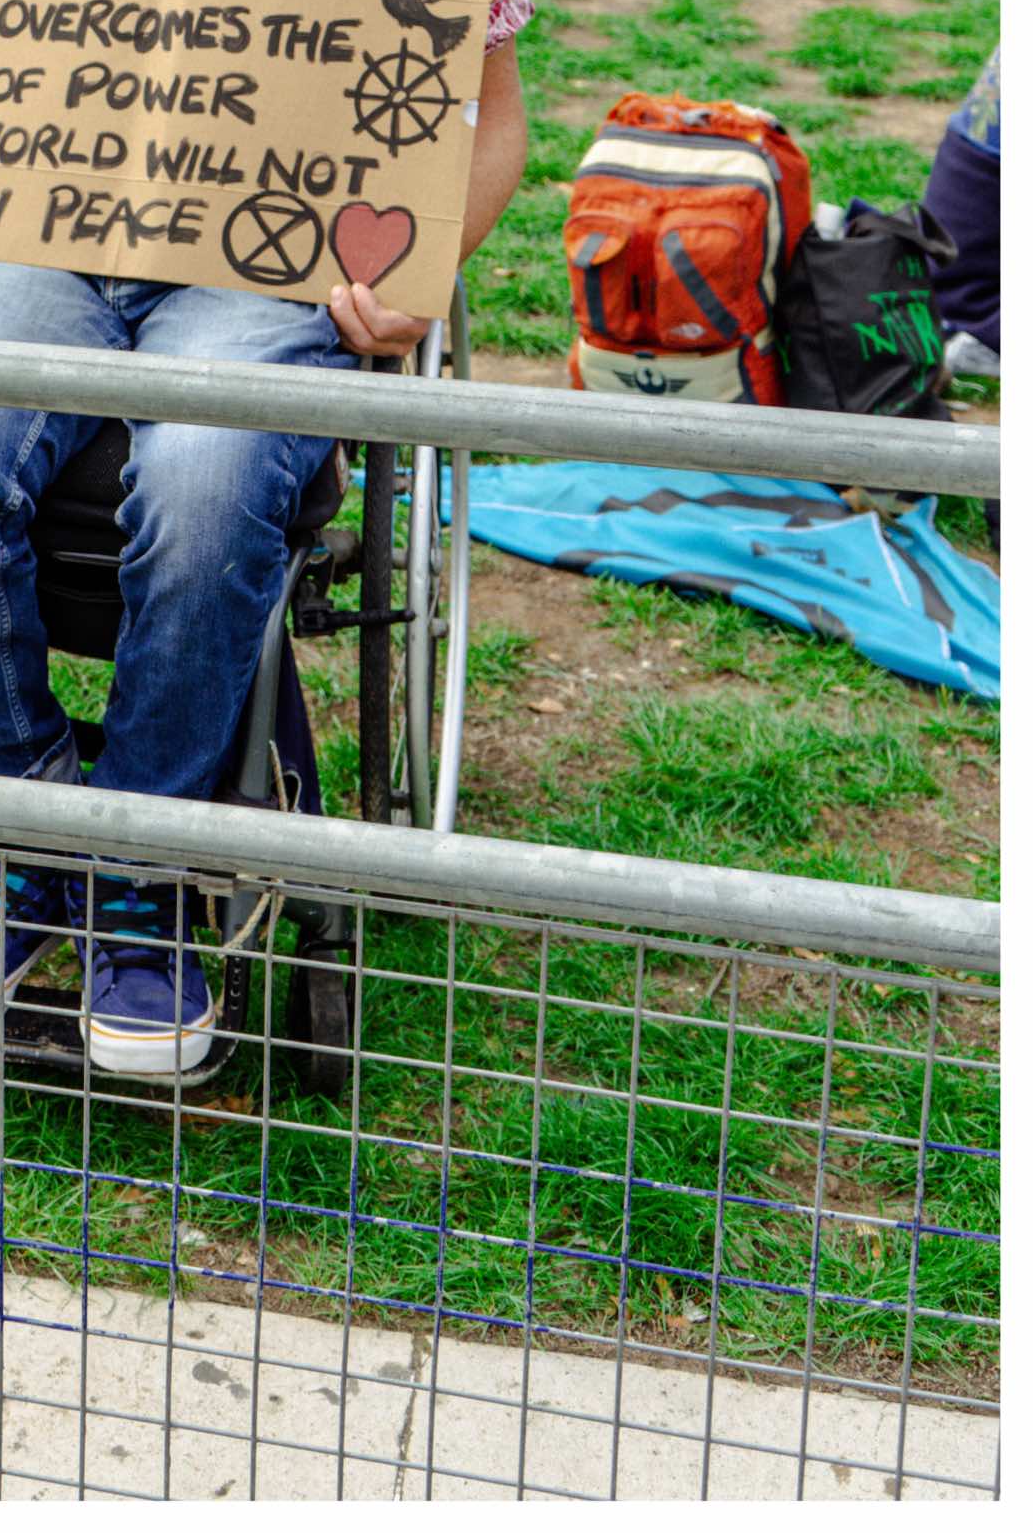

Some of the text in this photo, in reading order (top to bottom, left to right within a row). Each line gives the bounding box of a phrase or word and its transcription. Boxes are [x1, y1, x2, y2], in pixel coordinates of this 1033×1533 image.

[260, 13, 362, 65] THE
[65, 61, 259, 125] POWER
[147, 140, 244, 187] WILL
[257, 148, 380, 199] NOT
[41, 184, 208, 246] PEACE
